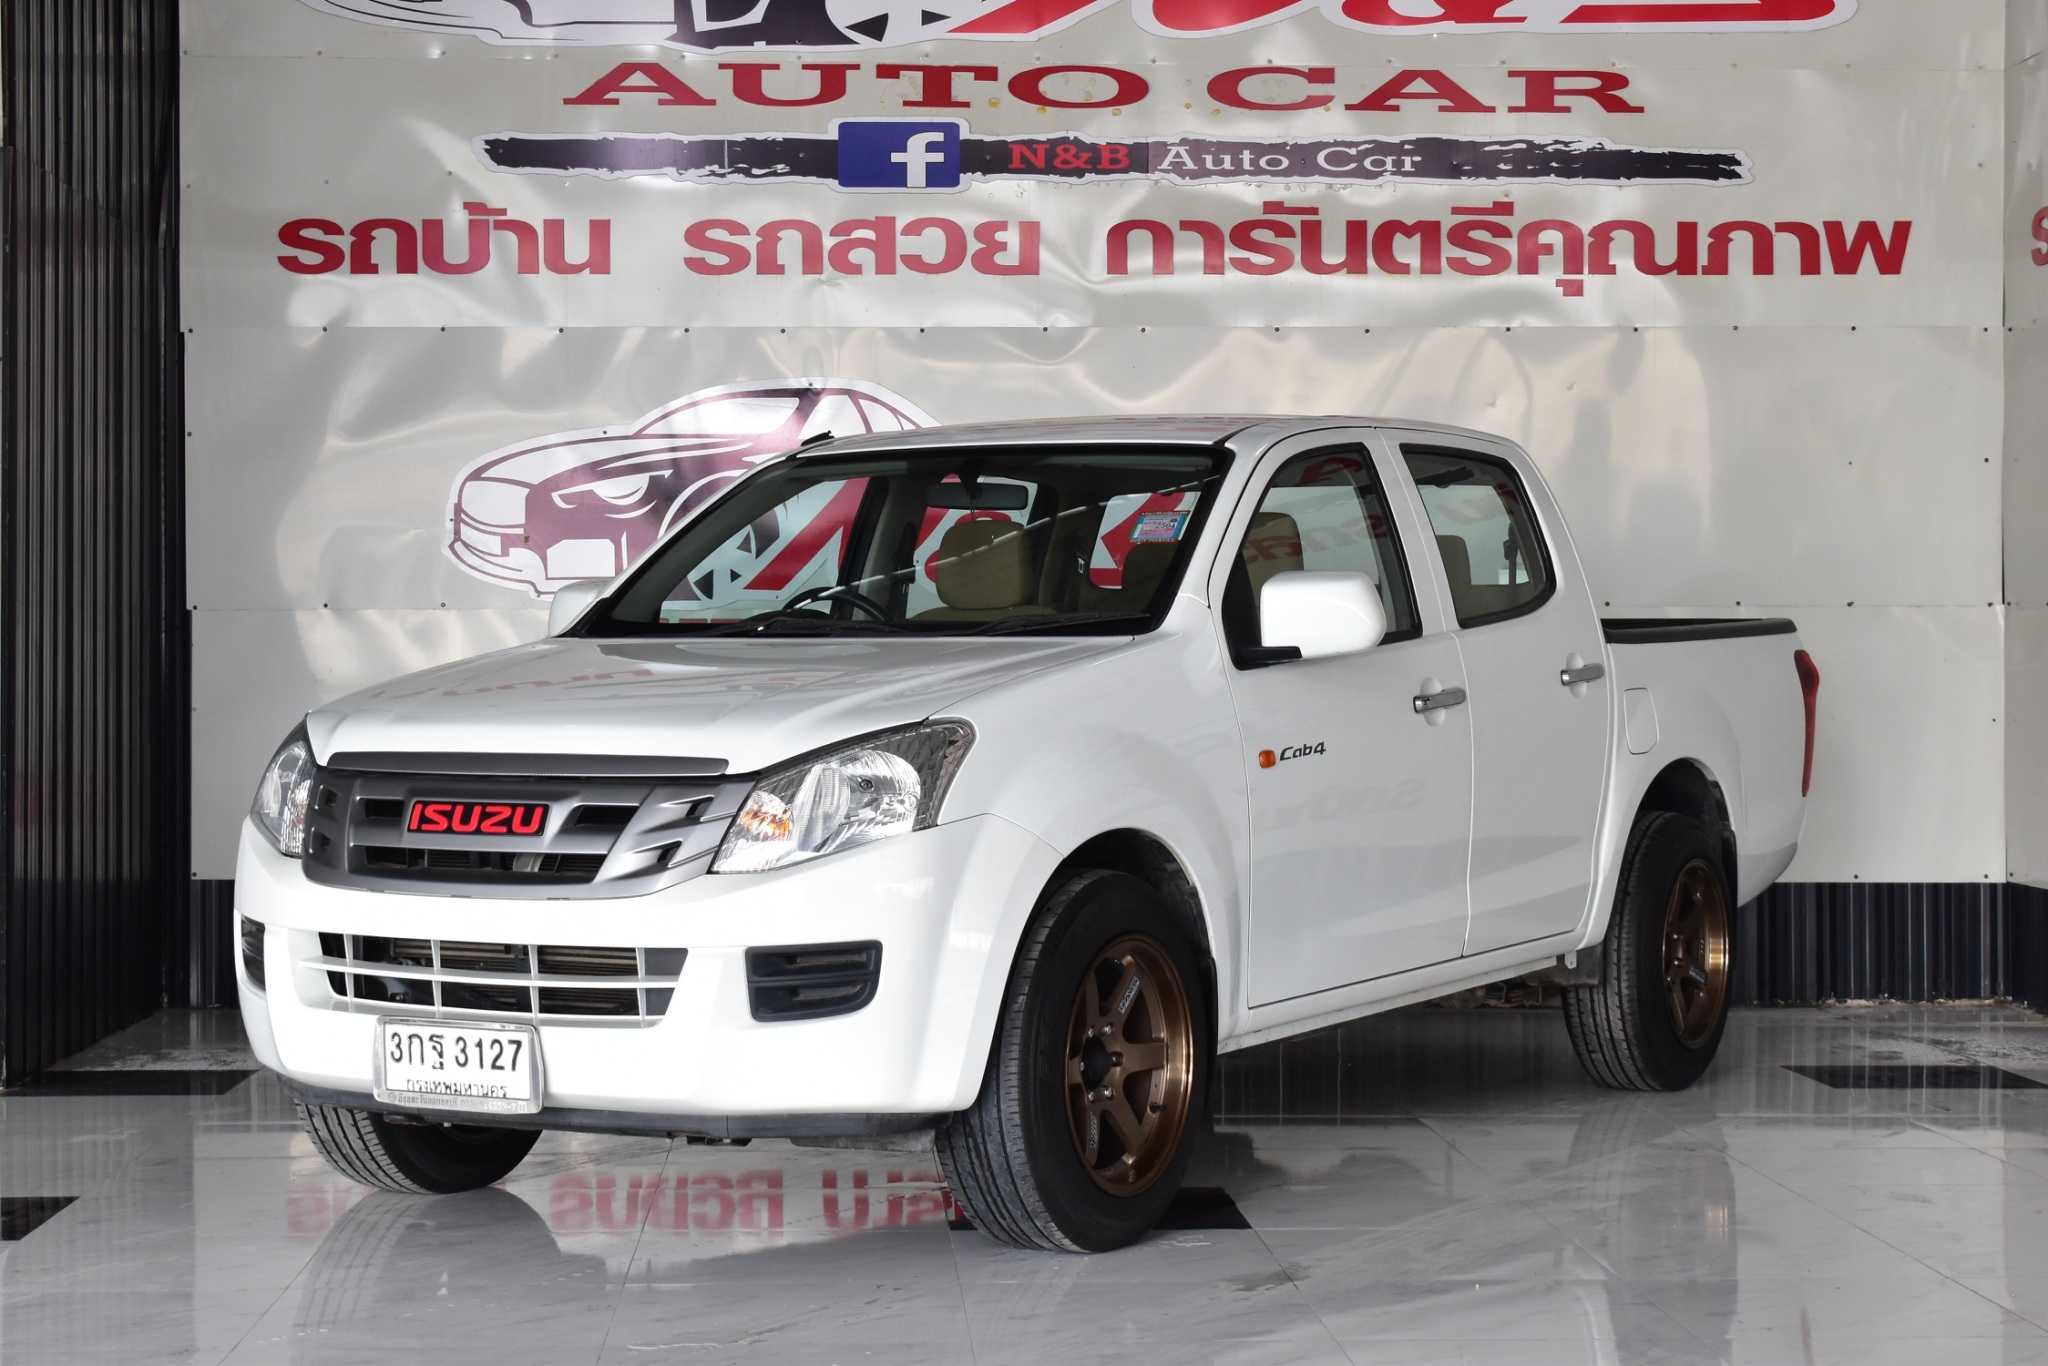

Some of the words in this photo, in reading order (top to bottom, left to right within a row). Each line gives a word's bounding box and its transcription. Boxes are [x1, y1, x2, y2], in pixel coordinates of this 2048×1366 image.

[563, 63, 1149, 110] AUTO
[1207, 66, 1645, 113] CAR
[1008, 143, 1131, 170] N&B
[1157, 145, 1290, 171] Auto
[1316, 146, 1423, 172] Car
[277, 202, 611, 275] รถบ้าน
[684, 216, 1040, 276] รถสวย
[1106, 201, 1913, 297] การันตรีคุณภาพ
[1279, 741, 1327, 762] Cab4
[409, 803, 545, 835] ISUZU
[390, 1032, 445, 1071] 3กฐ
[455, 1036, 523, 1072] 3127
[407, 1079, 507, 1098] กรงเทพมหานคร
